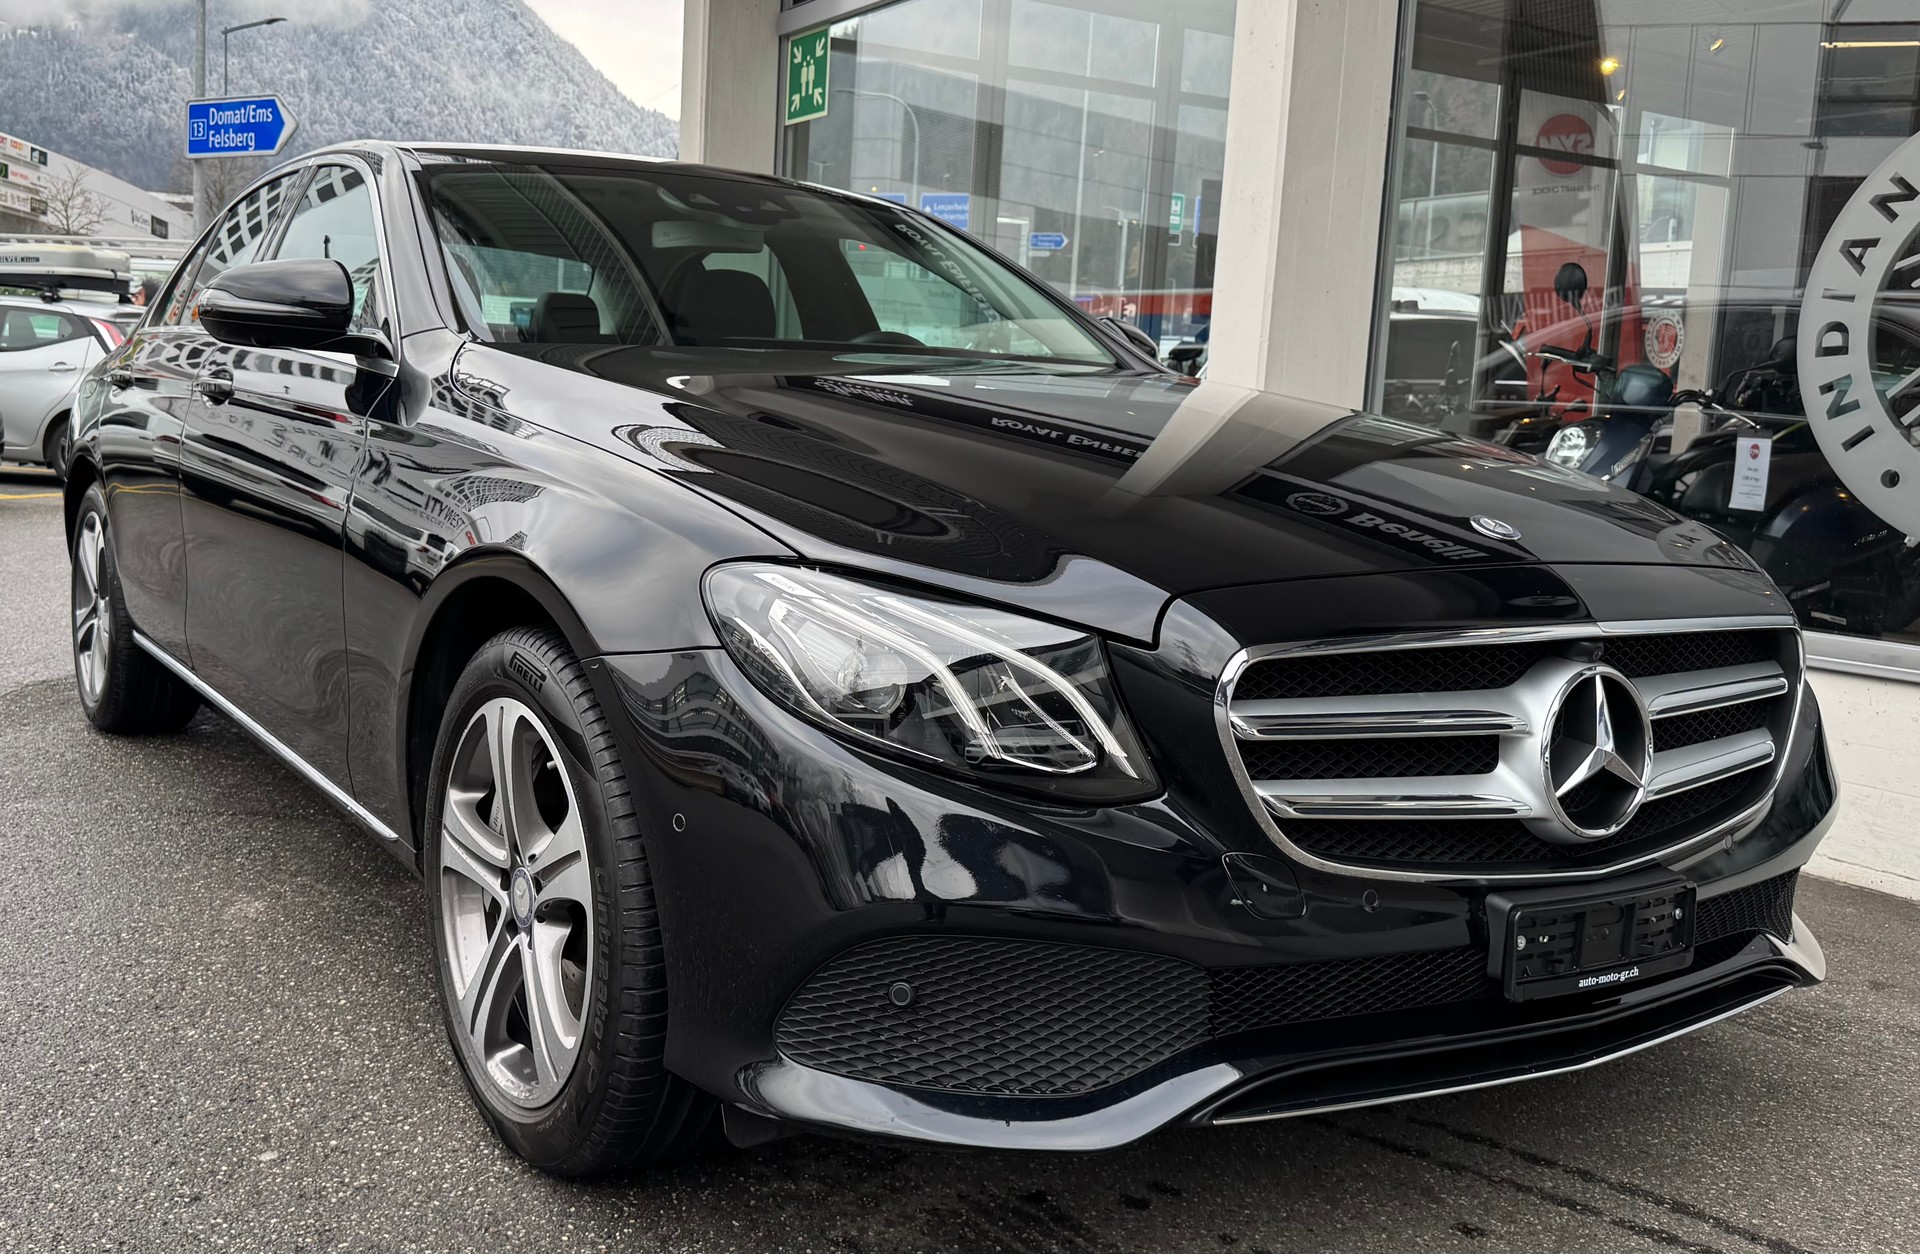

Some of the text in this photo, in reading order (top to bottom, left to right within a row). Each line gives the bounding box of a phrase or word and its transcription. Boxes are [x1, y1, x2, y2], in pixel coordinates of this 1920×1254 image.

[209, 105, 273, 126] Domat/Ems
[193, 122, 204, 137] 13
[208, 128, 255, 151] Felsberg
[1815, 172, 1920, 452] INDIAN
[509, 651, 548, 694] PIRELLI
[593, 865, 613, 1038] Cinturato
[1578, 966, 1639, 988] auto-moto-gr.ch
